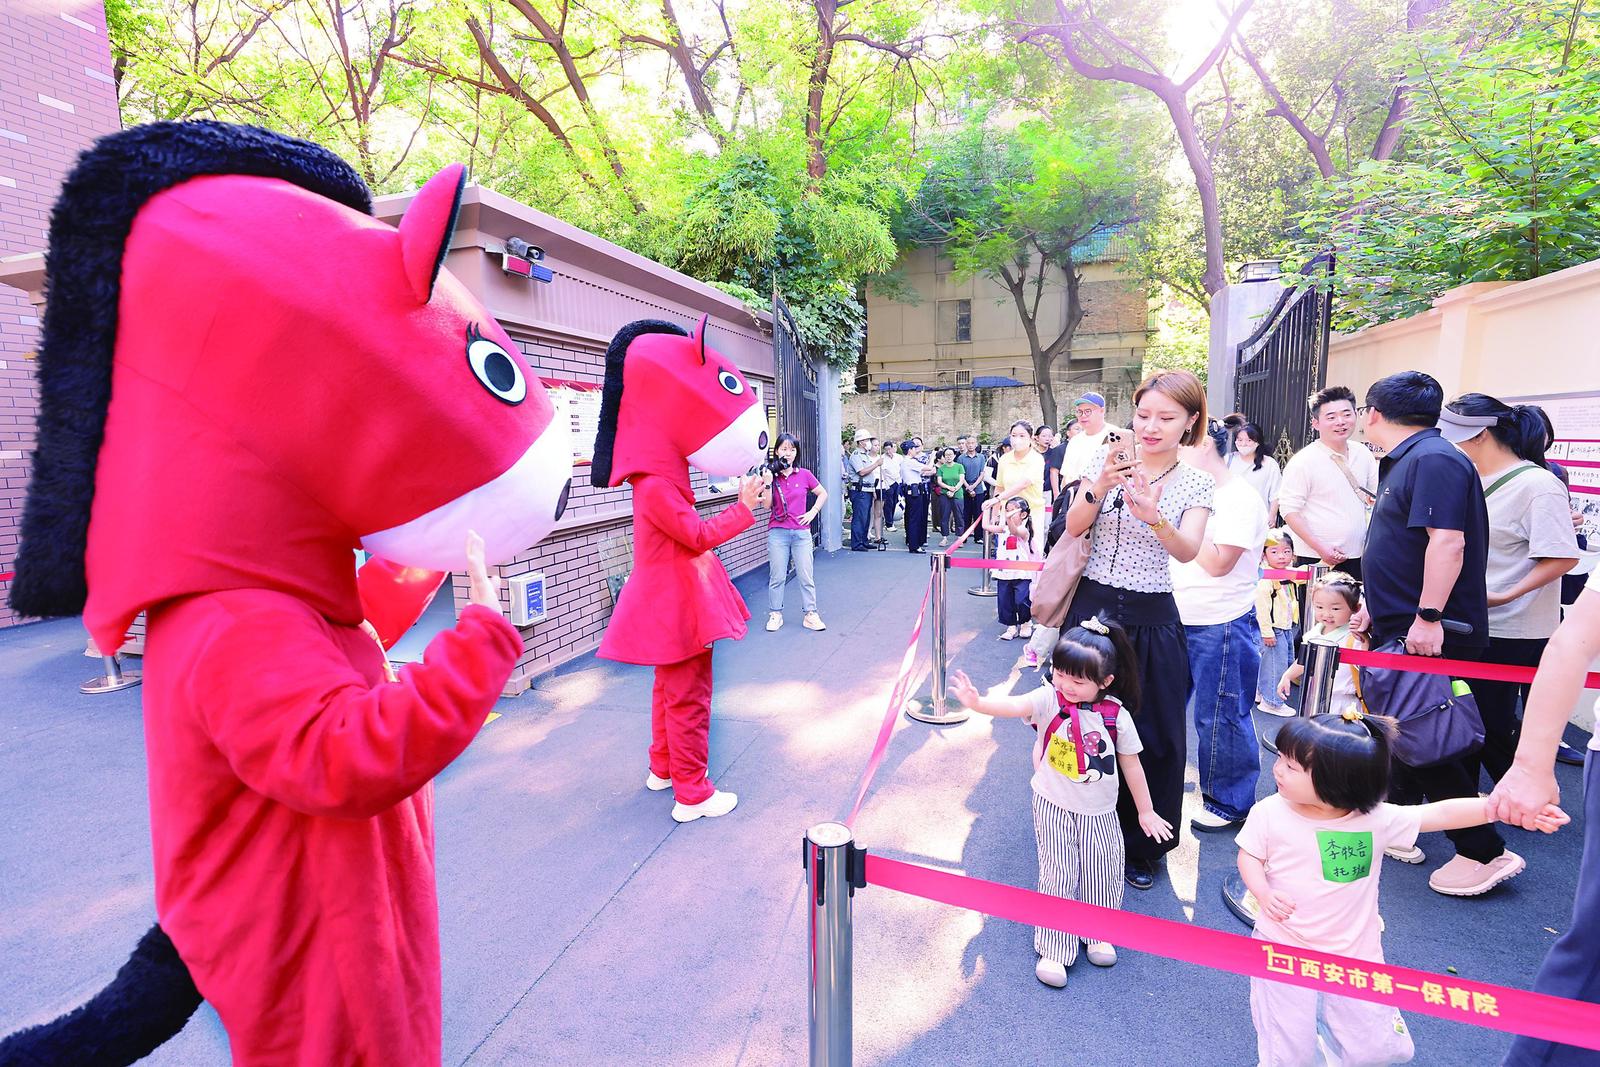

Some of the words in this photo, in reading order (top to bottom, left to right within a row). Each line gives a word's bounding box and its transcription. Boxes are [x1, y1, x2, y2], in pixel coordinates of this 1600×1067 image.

[1325, 839, 1367, 860] 李牧言
[1333, 864, 1366, 877] 托班
[1300, 958, 1500, 1017] 西安市第一保育院
